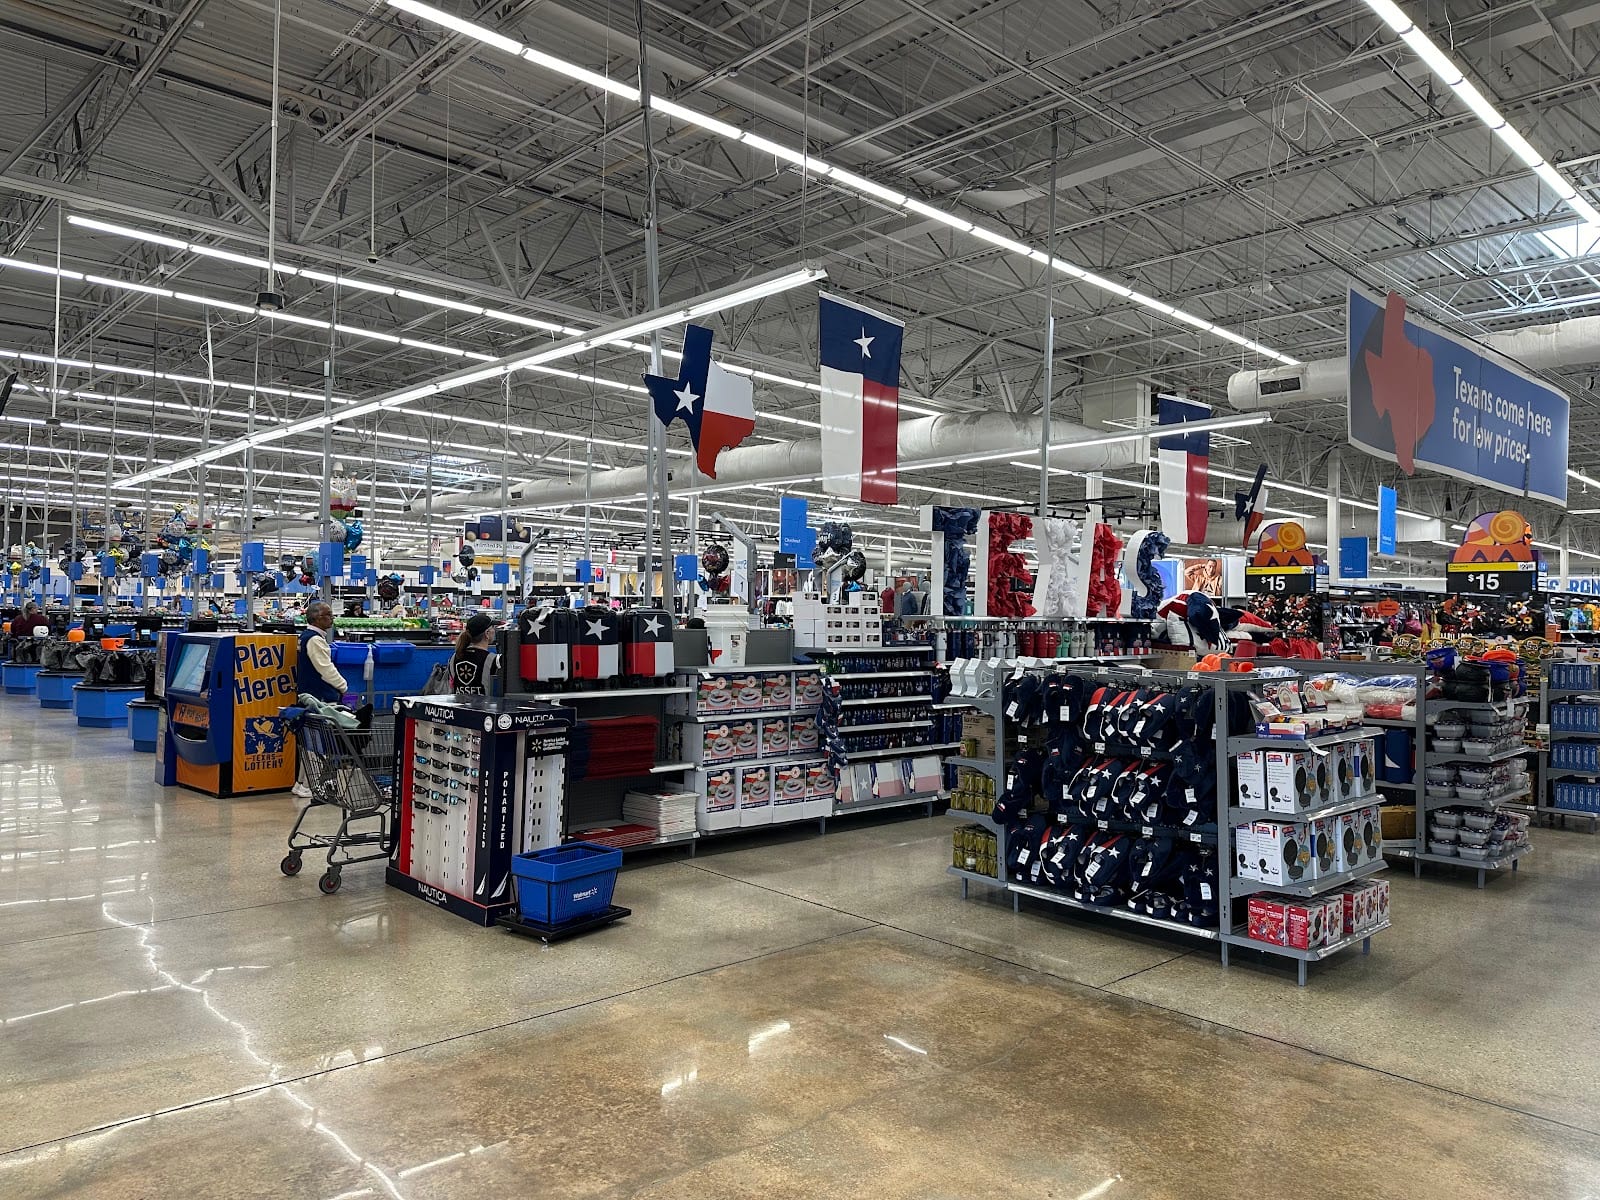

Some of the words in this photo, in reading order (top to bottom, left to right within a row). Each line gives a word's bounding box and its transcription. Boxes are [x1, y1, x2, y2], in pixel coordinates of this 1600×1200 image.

[1453, 365, 1493, 414] Texans
[1495, 396, 1525, 427] come
[1526, 401, 1552, 437] here
[1452, 407, 1472, 444] for
[1473, 416, 1493, 452] low
[920, 504, 1171, 619] TEXAS
[1260, 576, 1286, 591] $15
[1467, 573, 1500, 591] $15
[235, 643, 286, 673] Play
[235, 665, 299, 705] Here!
[455, 686, 482, 695] ASSET
[424, 705, 455, 720] NAUTICA
[515, 714, 554, 724] NAUTICA
[244, 758, 283, 771] LOTTERY
[252, 753, 276, 761] TEXAS
[481, 770, 489, 849] POLARIZED
[499, 771, 509, 849] POLARIZED
[417, 882, 448, 904] NAUTICA
